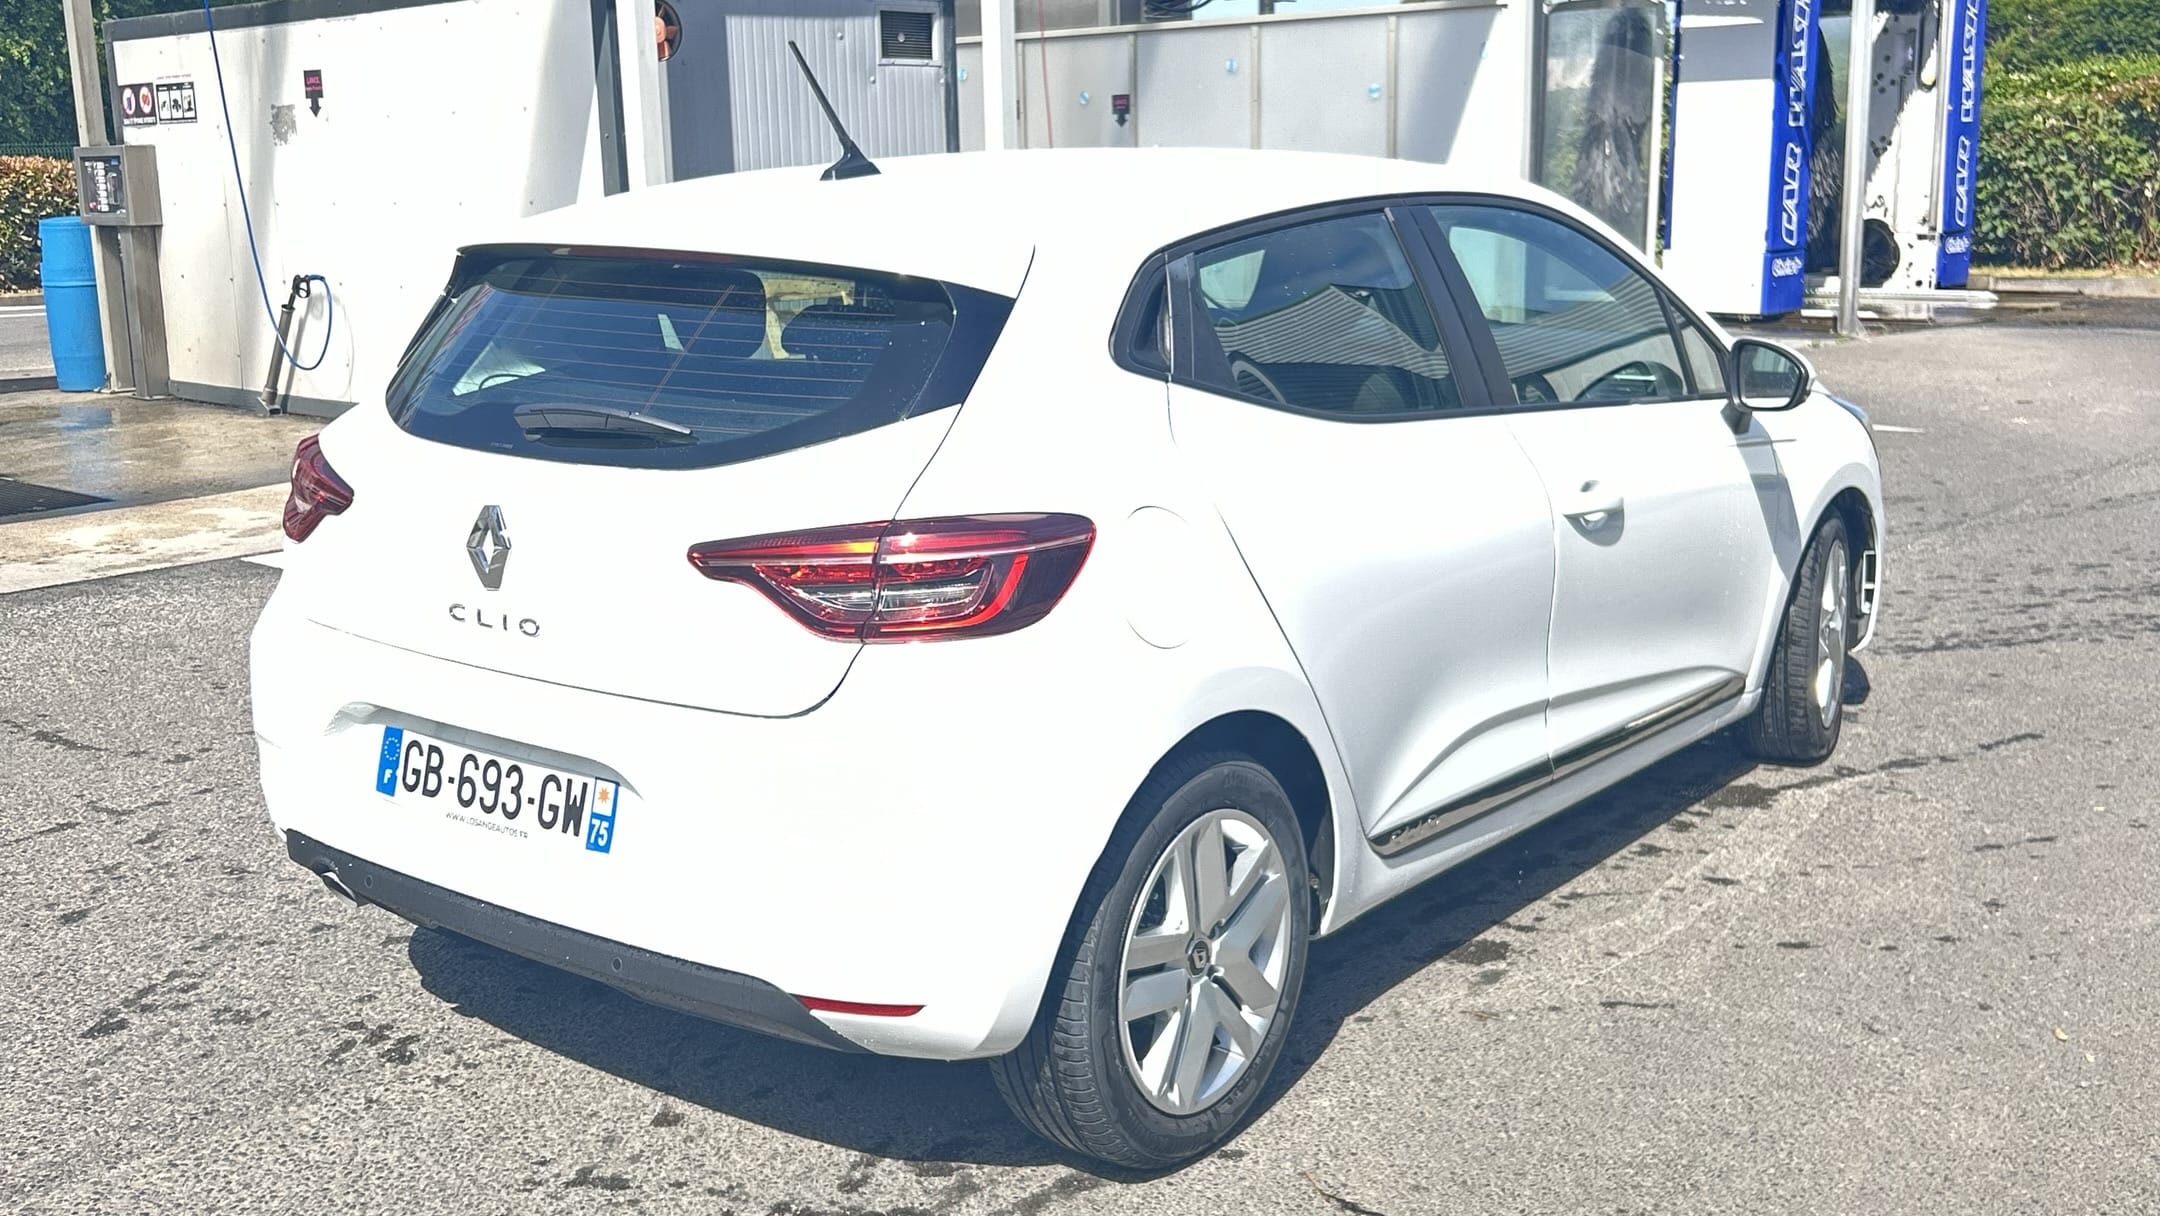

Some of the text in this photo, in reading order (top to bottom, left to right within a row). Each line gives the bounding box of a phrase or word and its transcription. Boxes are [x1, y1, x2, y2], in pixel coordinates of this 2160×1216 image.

[1782, 141, 1802, 246] CAR
[1955, 135, 1971, 227] CAR
[449, 603, 540, 638] CLIO
[383, 768, 392, 784] F
[402, 739, 588, 838] GB-693-GW
[590, 818, 609, 847] 75
